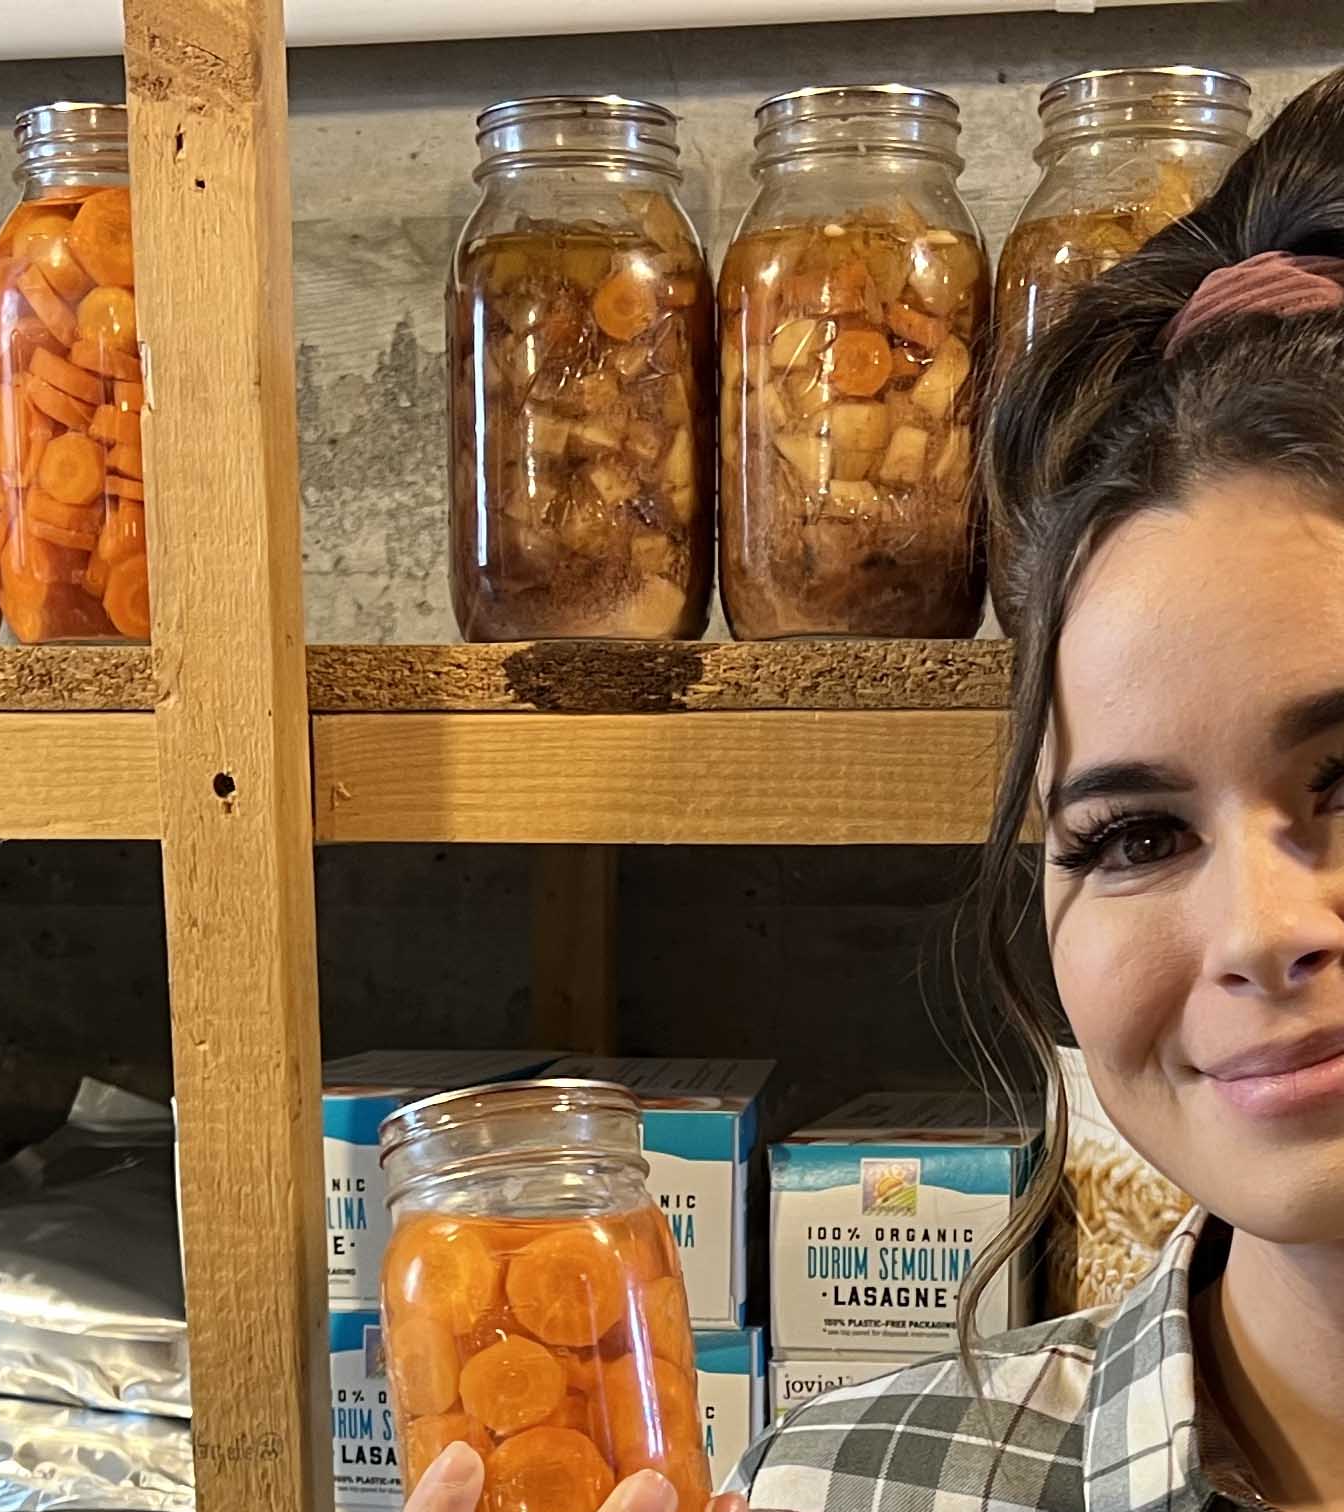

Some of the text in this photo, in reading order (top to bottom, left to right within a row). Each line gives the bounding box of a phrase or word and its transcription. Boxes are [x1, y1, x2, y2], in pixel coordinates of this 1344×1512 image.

[807, 1226, 974, 1243] 100% ORGANIC
[807, 1245, 869, 1281] DURUM
[833, 1285, 948, 1308] LASAGNE
